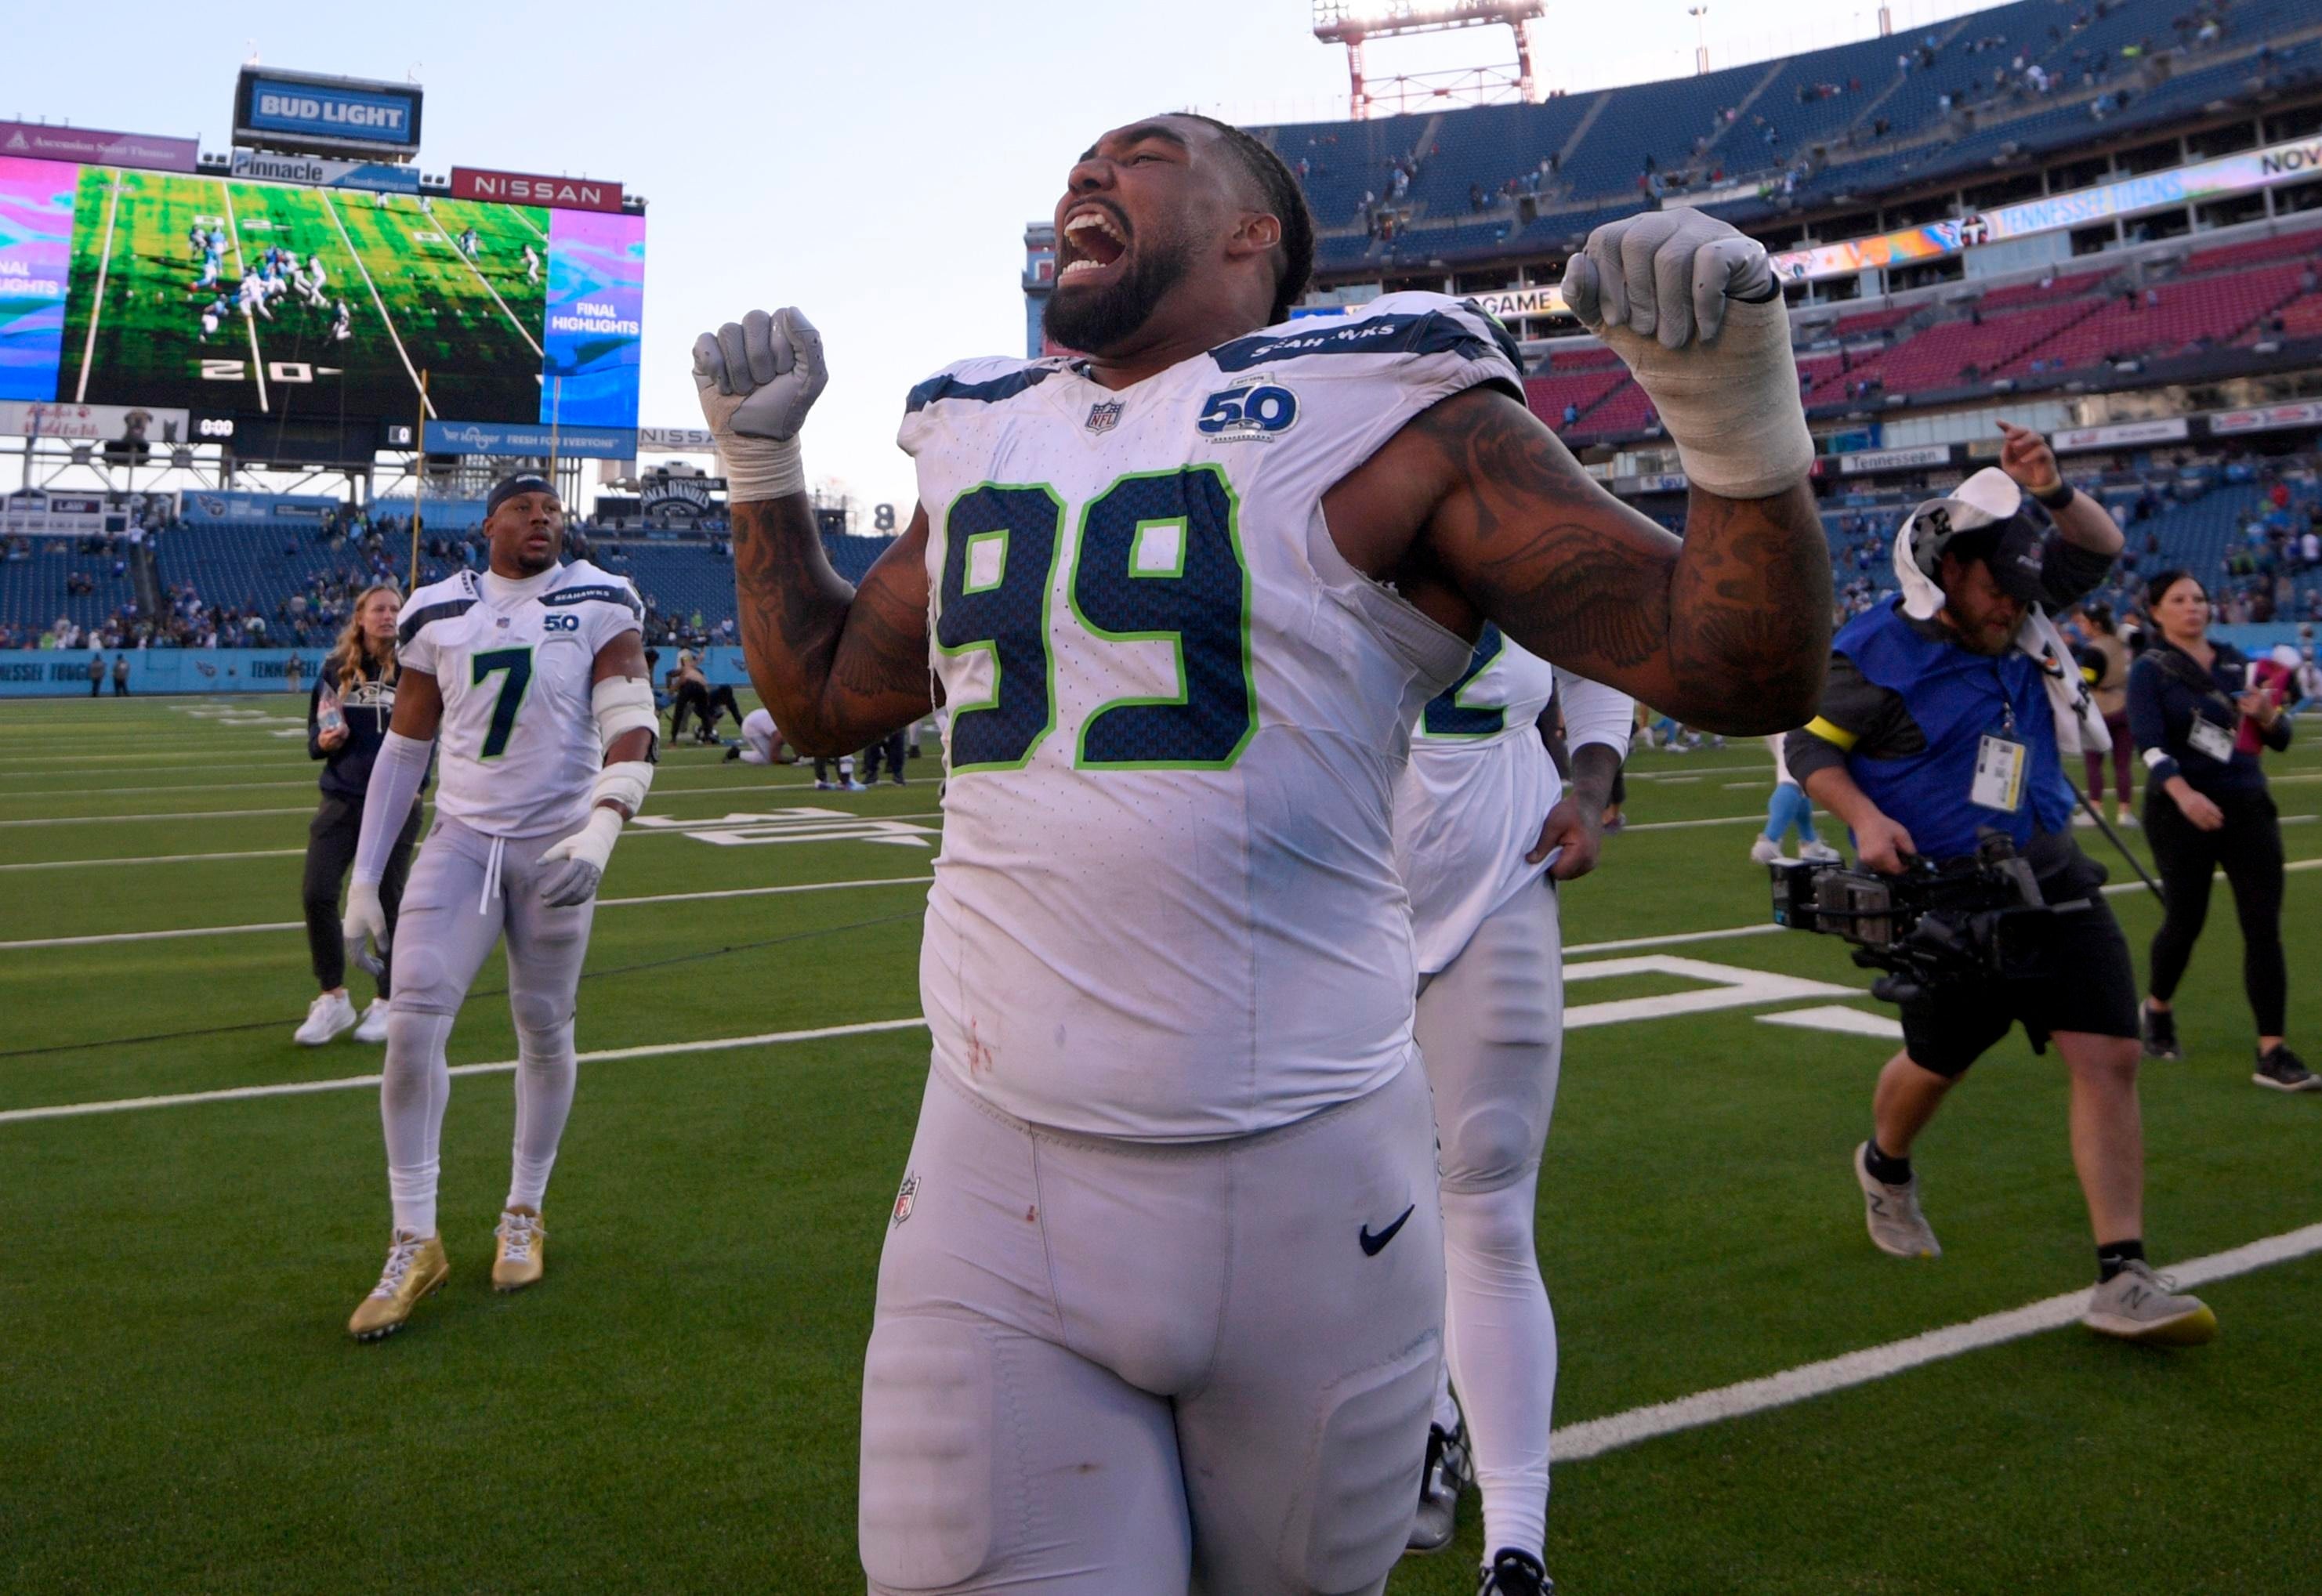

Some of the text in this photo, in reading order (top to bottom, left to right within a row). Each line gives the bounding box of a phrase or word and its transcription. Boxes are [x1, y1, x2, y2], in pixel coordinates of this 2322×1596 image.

[260, 95, 404, 128] BUD LIGHT
[235, 154, 323, 183] Pinnacle
[2262, 147, 2322, 176] NOV
[474, 176, 601, 205] NISSAN
[2001, 171, 2183, 233] TENNESSEE TITANS
[576, 302, 617, 318] FINAL
[1483, 291, 1552, 314] GAME
[552, 315, 639, 335] HIGHLIGHTS
[1251, 324, 1395, 358] SEAHWKS
[1090, 414, 1114, 427] NFL
[1198, 385, 1297, 433] 50
[200, 418, 234, 436] 0:00
[460, 426, 501, 449] Kroger
[506, 434, 538, 445] FRESH
[1853, 450, 1936, 469] Tennessean
[875, 504, 895, 530] 8
[554, 590, 610, 602] SEAHAWKS
[545, 614, 579, 632] 50
[936, 462, 1260, 778] 99
[471, 646, 534, 762] 7
